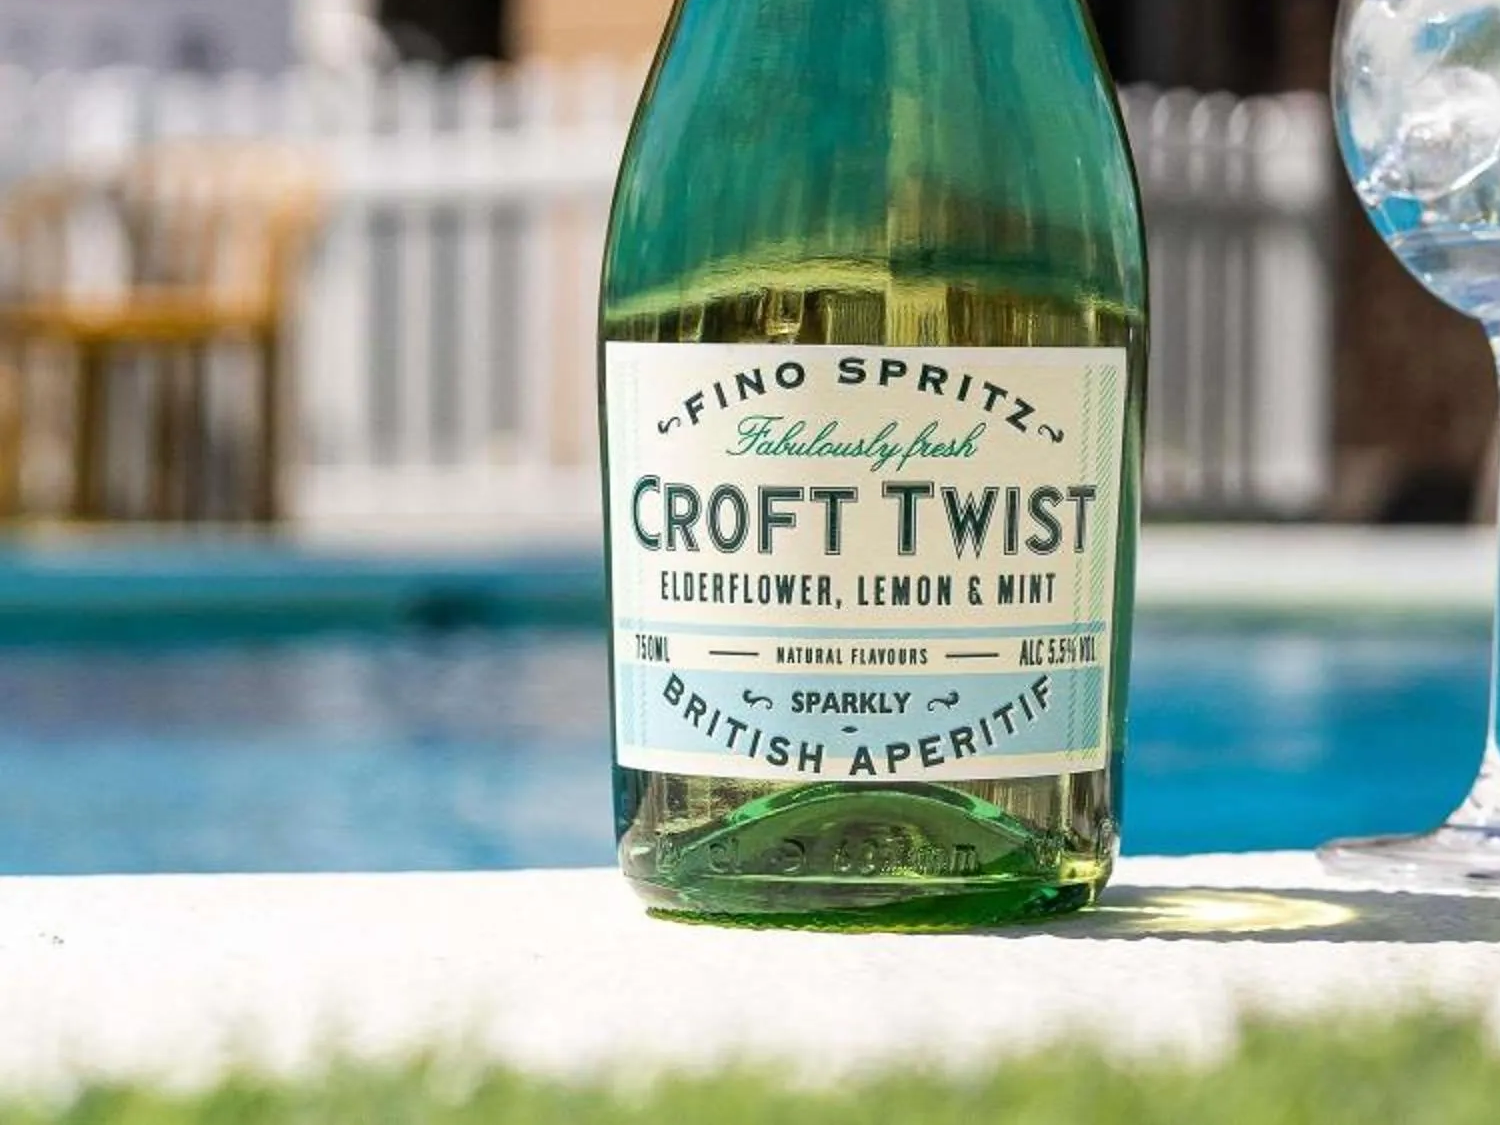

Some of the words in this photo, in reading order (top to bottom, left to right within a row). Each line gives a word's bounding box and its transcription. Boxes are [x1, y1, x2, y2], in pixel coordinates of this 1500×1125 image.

[684, 361, 806, 425] FINO
[837, 356, 1036, 433] SPRITZ
[725, 415, 902, 472] Fabulously
[894, 420, 988, 472] fresh
[630, 474, 859, 556] CROFT
[881, 480, 1098, 561] TWIST
[660, 570, 842, 610] ELDERFLOWER,
[857, 574, 952, 606] LEMON
[967, 575, 985, 606] &
[997, 572, 1057, 605] MINT
[635, 633, 671, 663] 750ML
[776, 646, 844, 665] NATURAL
[850, 647, 929, 665] FLAVOURS
[1018, 638, 1045, 667] ALC
[1047, 636, 1077, 665] 5.5%
[791, 690, 912, 714] SPARKLY
[662, 672, 825, 774] BRITISH
[848, 674, 1053, 777] APERITIF
